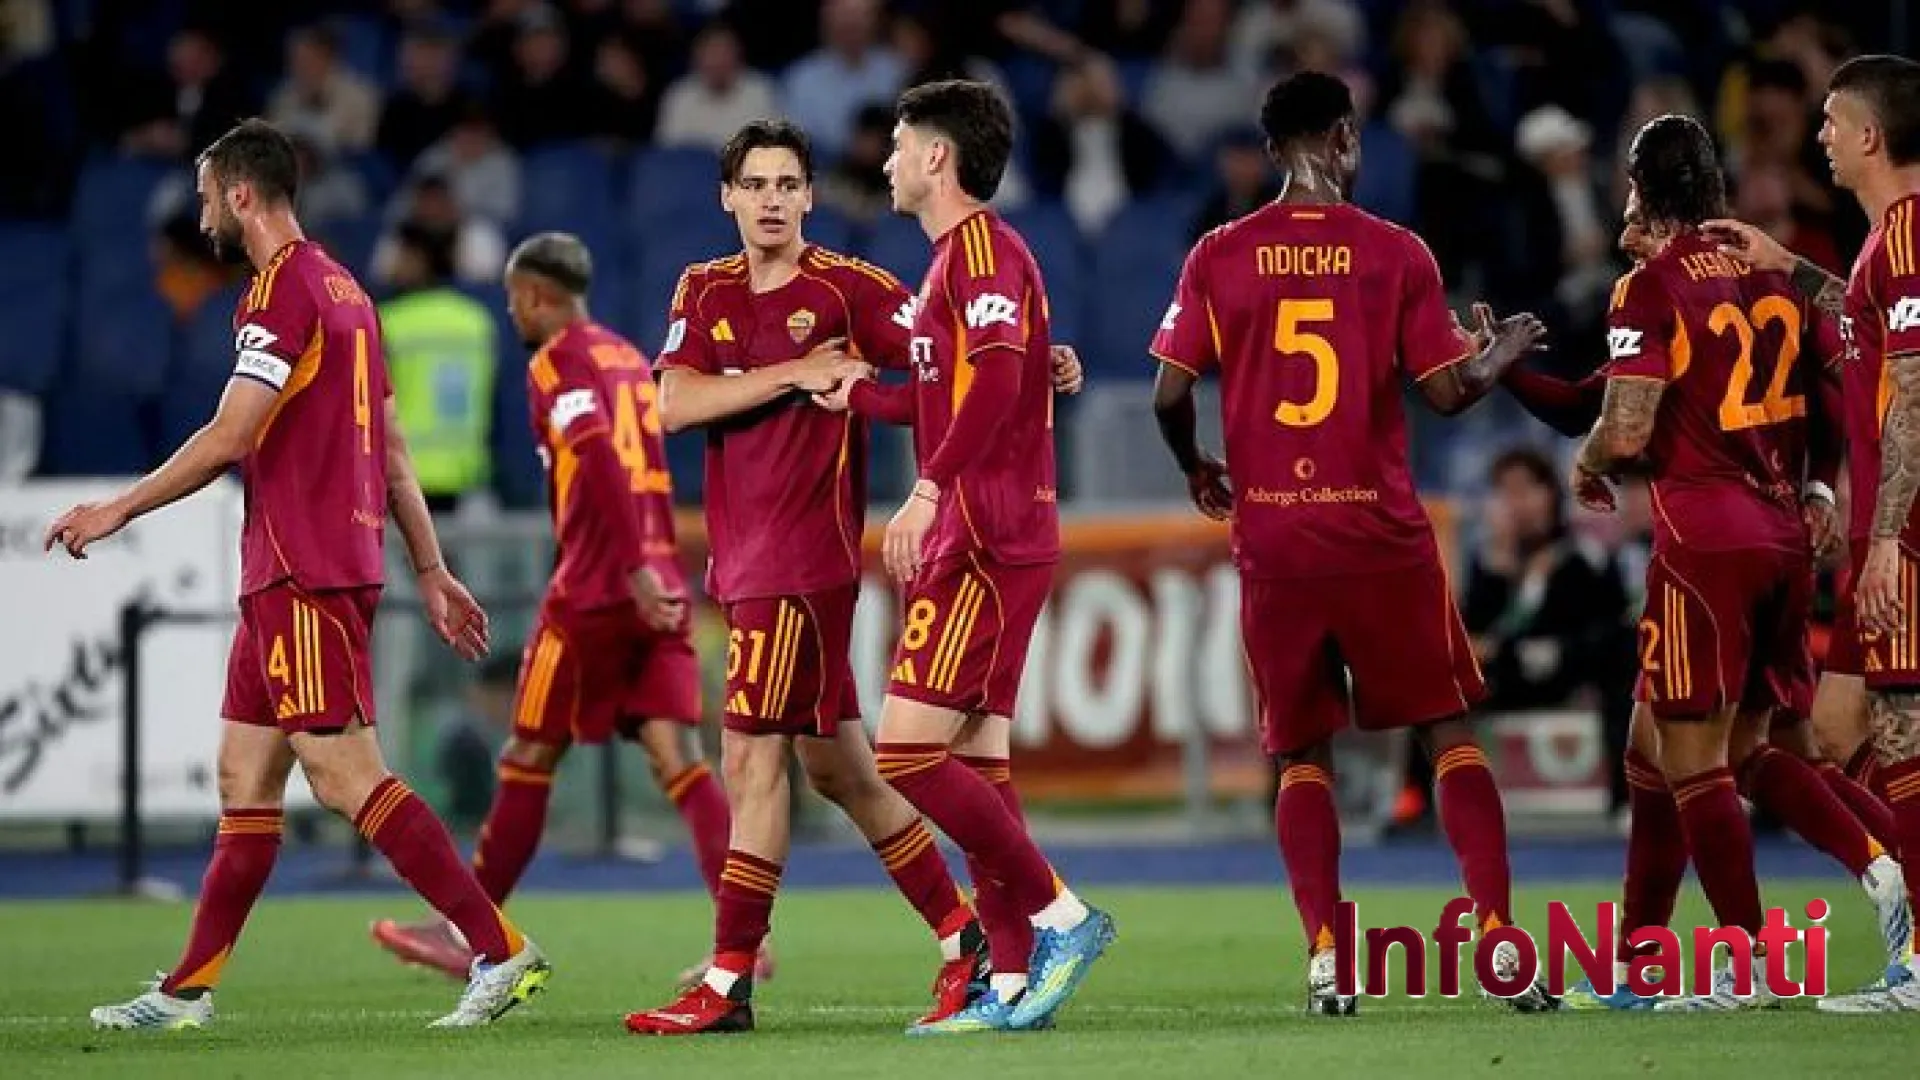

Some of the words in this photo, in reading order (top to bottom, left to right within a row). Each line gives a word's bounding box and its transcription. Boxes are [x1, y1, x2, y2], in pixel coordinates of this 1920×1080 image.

[1255, 245, 1351, 275] NDICKA
[353, 328, 372, 455] 4
[1273, 298, 1340, 427] 5
[1707, 294, 1806, 432] 22
[268, 635, 291, 685] 4
[727, 627, 766, 684] 61
